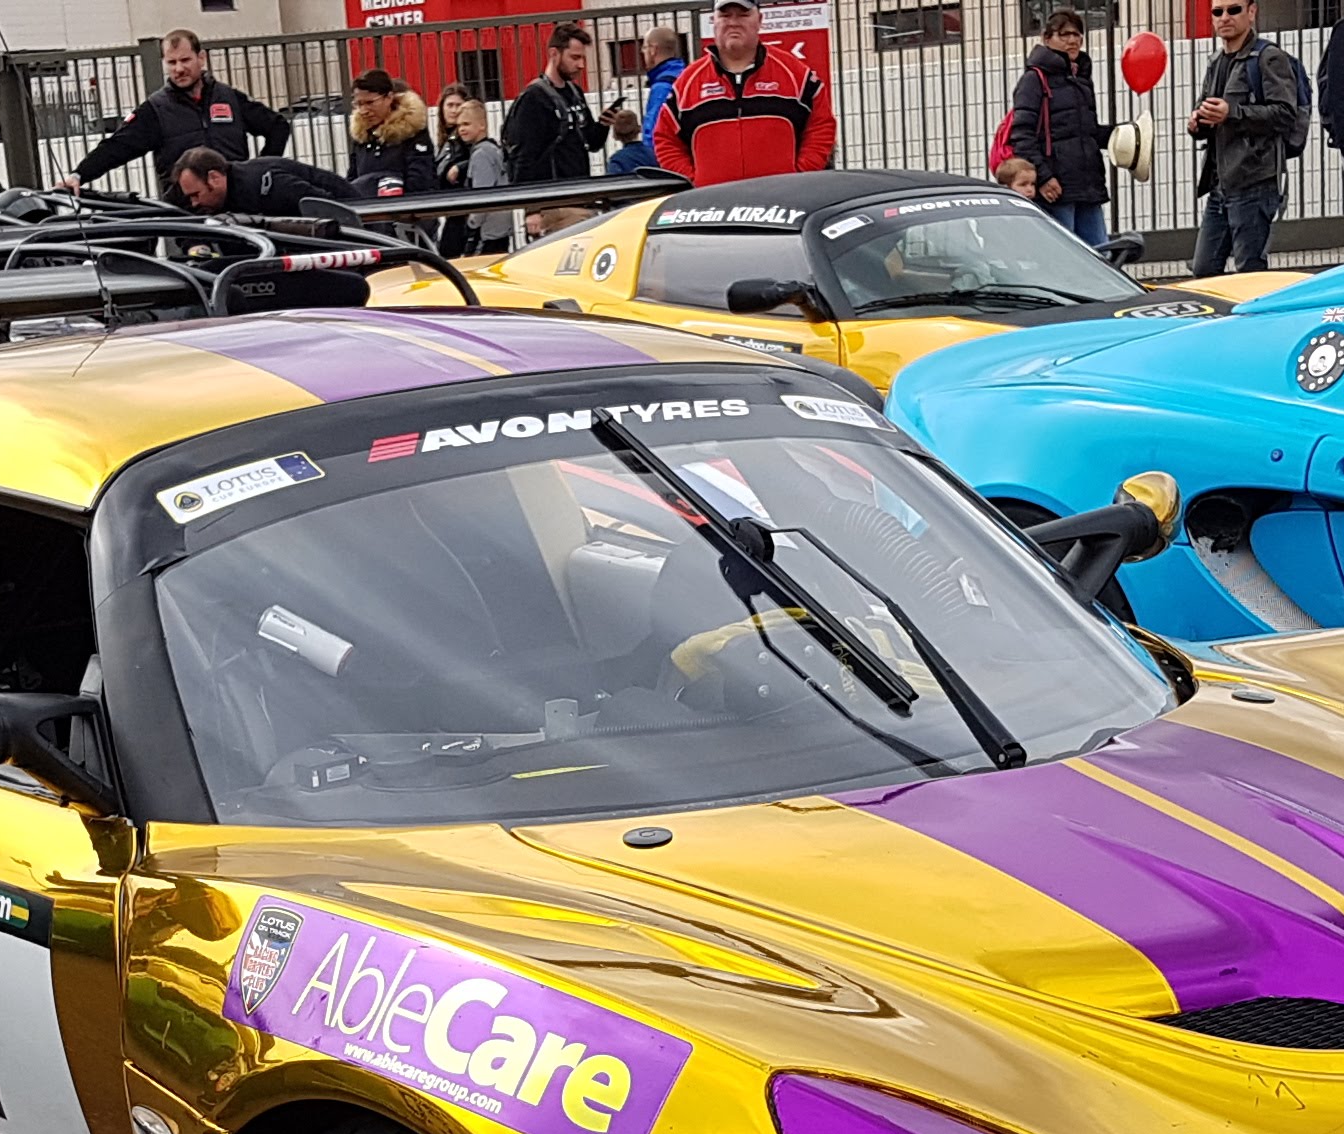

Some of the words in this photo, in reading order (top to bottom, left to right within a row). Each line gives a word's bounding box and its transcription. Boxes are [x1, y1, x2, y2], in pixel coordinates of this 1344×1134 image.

[361, 0, 425, 11] MEDI
[365, 10, 424, 28] CENTER
[671, 208, 723, 224] István
[728, 206, 806, 224] KIRÁLY
[231, 281, 275, 297] arco
[421, 409, 593, 452] AVON
[604, 399, 750, 425] TYRES
[201, 466, 277, 497] LOTUS
[261, 915, 296, 932] LOTUS
[291, 932, 631, 1133] AbleCare
[344, 1041, 503, 1115] www.ablecaregroup.com
